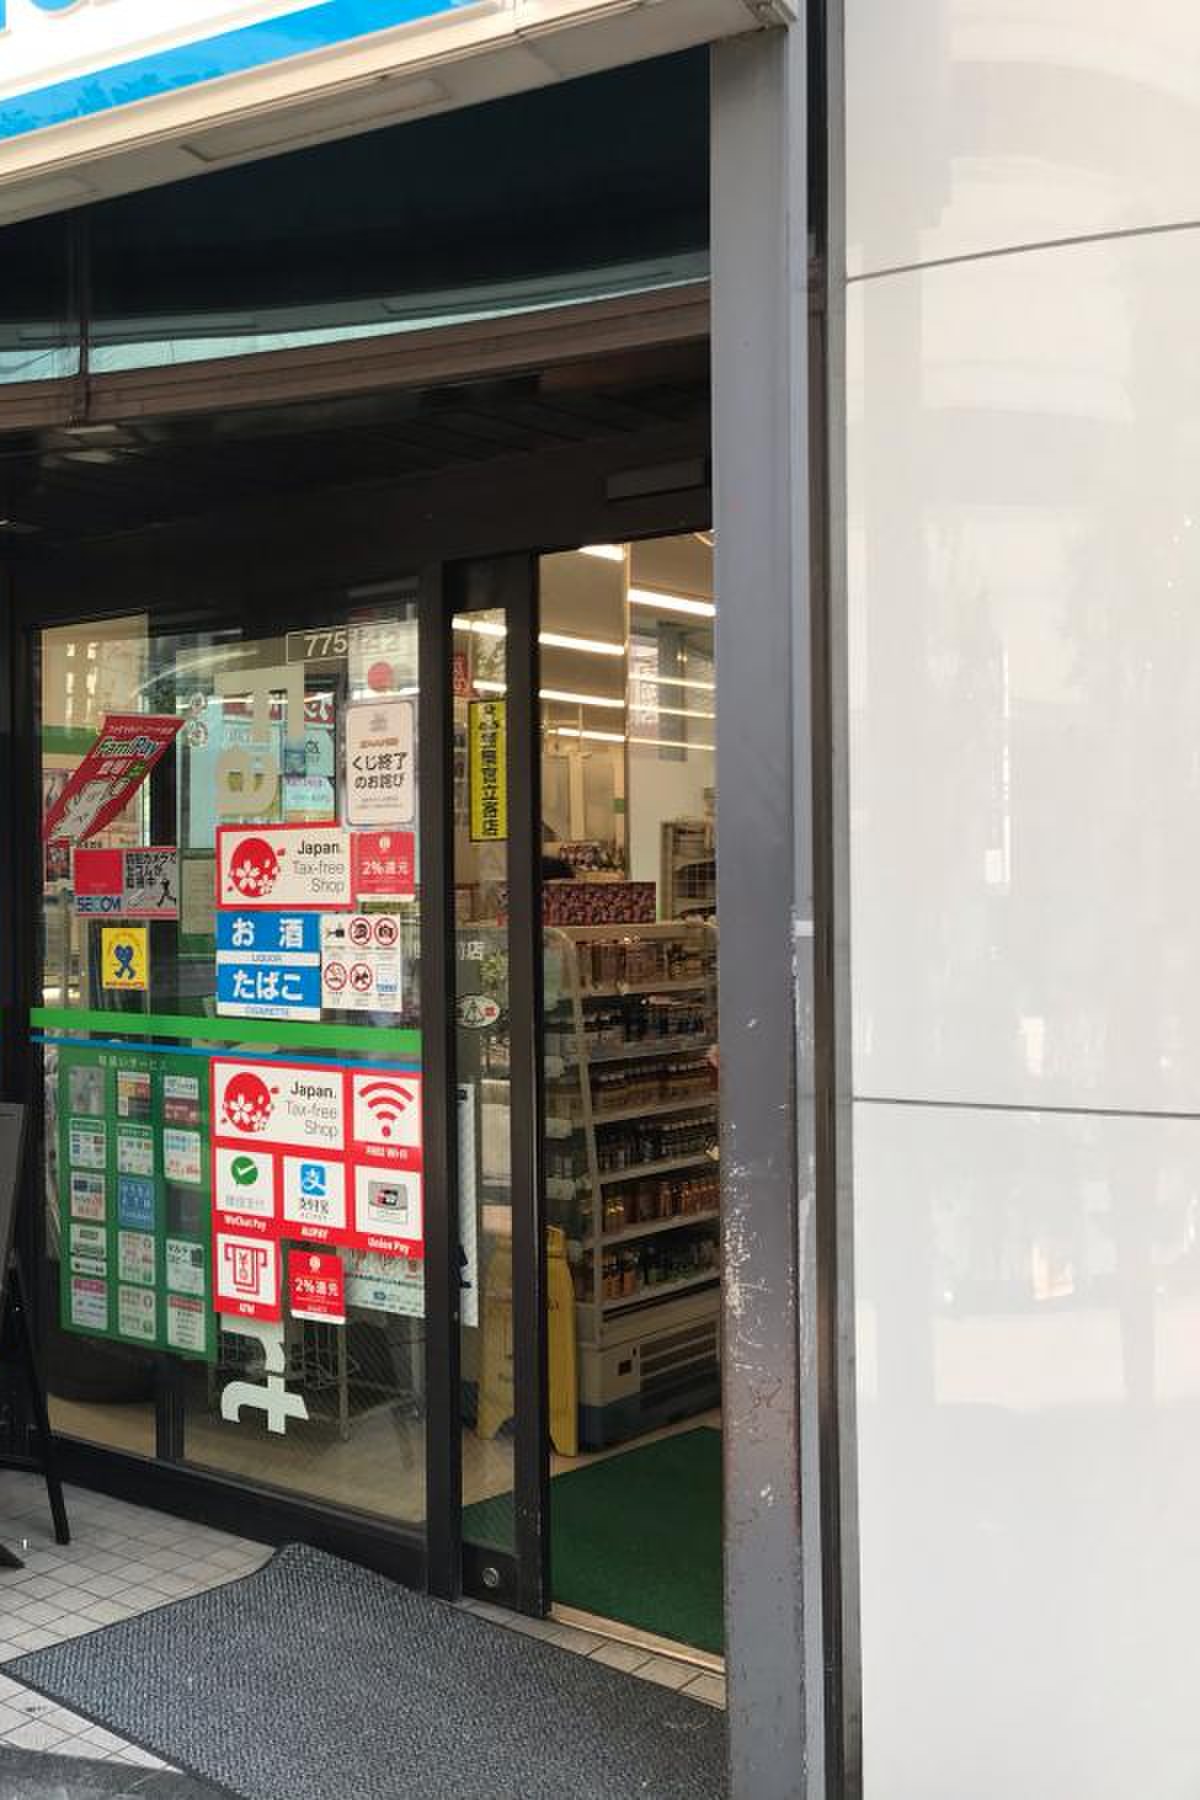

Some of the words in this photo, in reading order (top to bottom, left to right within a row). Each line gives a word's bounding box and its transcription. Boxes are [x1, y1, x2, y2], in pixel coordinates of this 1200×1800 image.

[303, 631, 348, 658] 775
[351, 752, 408, 771] くじ終了
[354, 773, 406, 790] のお詫び
[232, 969, 304, 1001] たばこ
